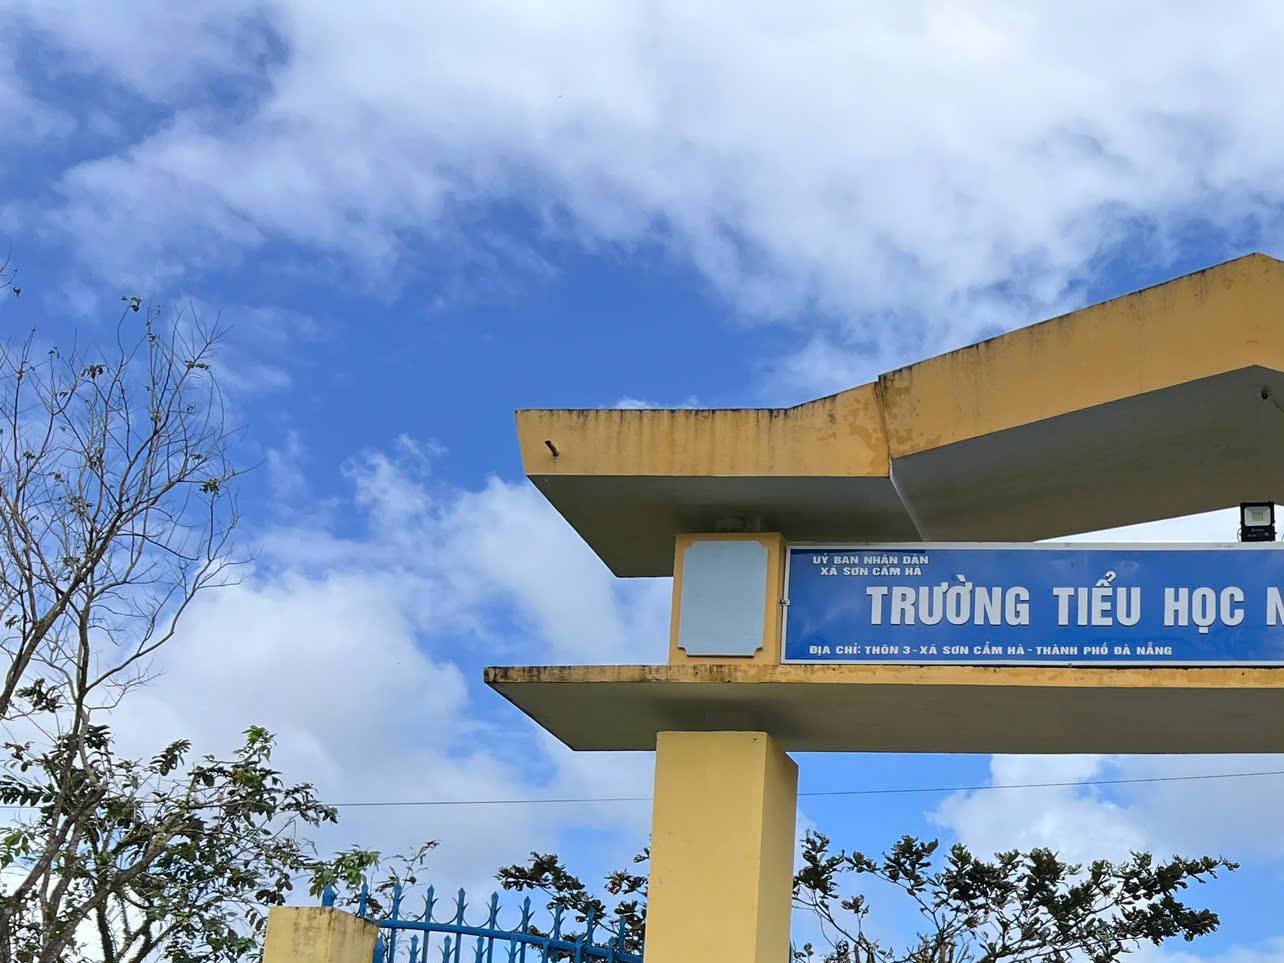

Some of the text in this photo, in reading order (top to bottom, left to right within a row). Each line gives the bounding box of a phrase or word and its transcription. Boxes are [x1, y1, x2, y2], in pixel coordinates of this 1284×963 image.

[833, 555, 859, 565] BAN
[863, 553, 898, 565] NHÂN
[902, 553, 929, 565] DÂN
[842, 565, 869, 576] SƠN
[865, 574, 1031, 626] TRƯỜNG
[1052, 570, 1141, 627] TIỂU
[1164, 585, 1246, 634] HỌC
[809, 645, 831, 657] ĐỊA
[864, 644, 900, 655] THÔN
[942, 645, 969, 655] SƠN
[973, 642, 1003, 655] CẨM
[1007, 644, 1025, 655] HÀ
[1036, 644, 1078, 655] THÀNH
[1083, 642, 1109, 655] PHỐ
[1113, 644, 1131, 655] ĐÀ
[1136, 642, 1173, 656] NẴNG
